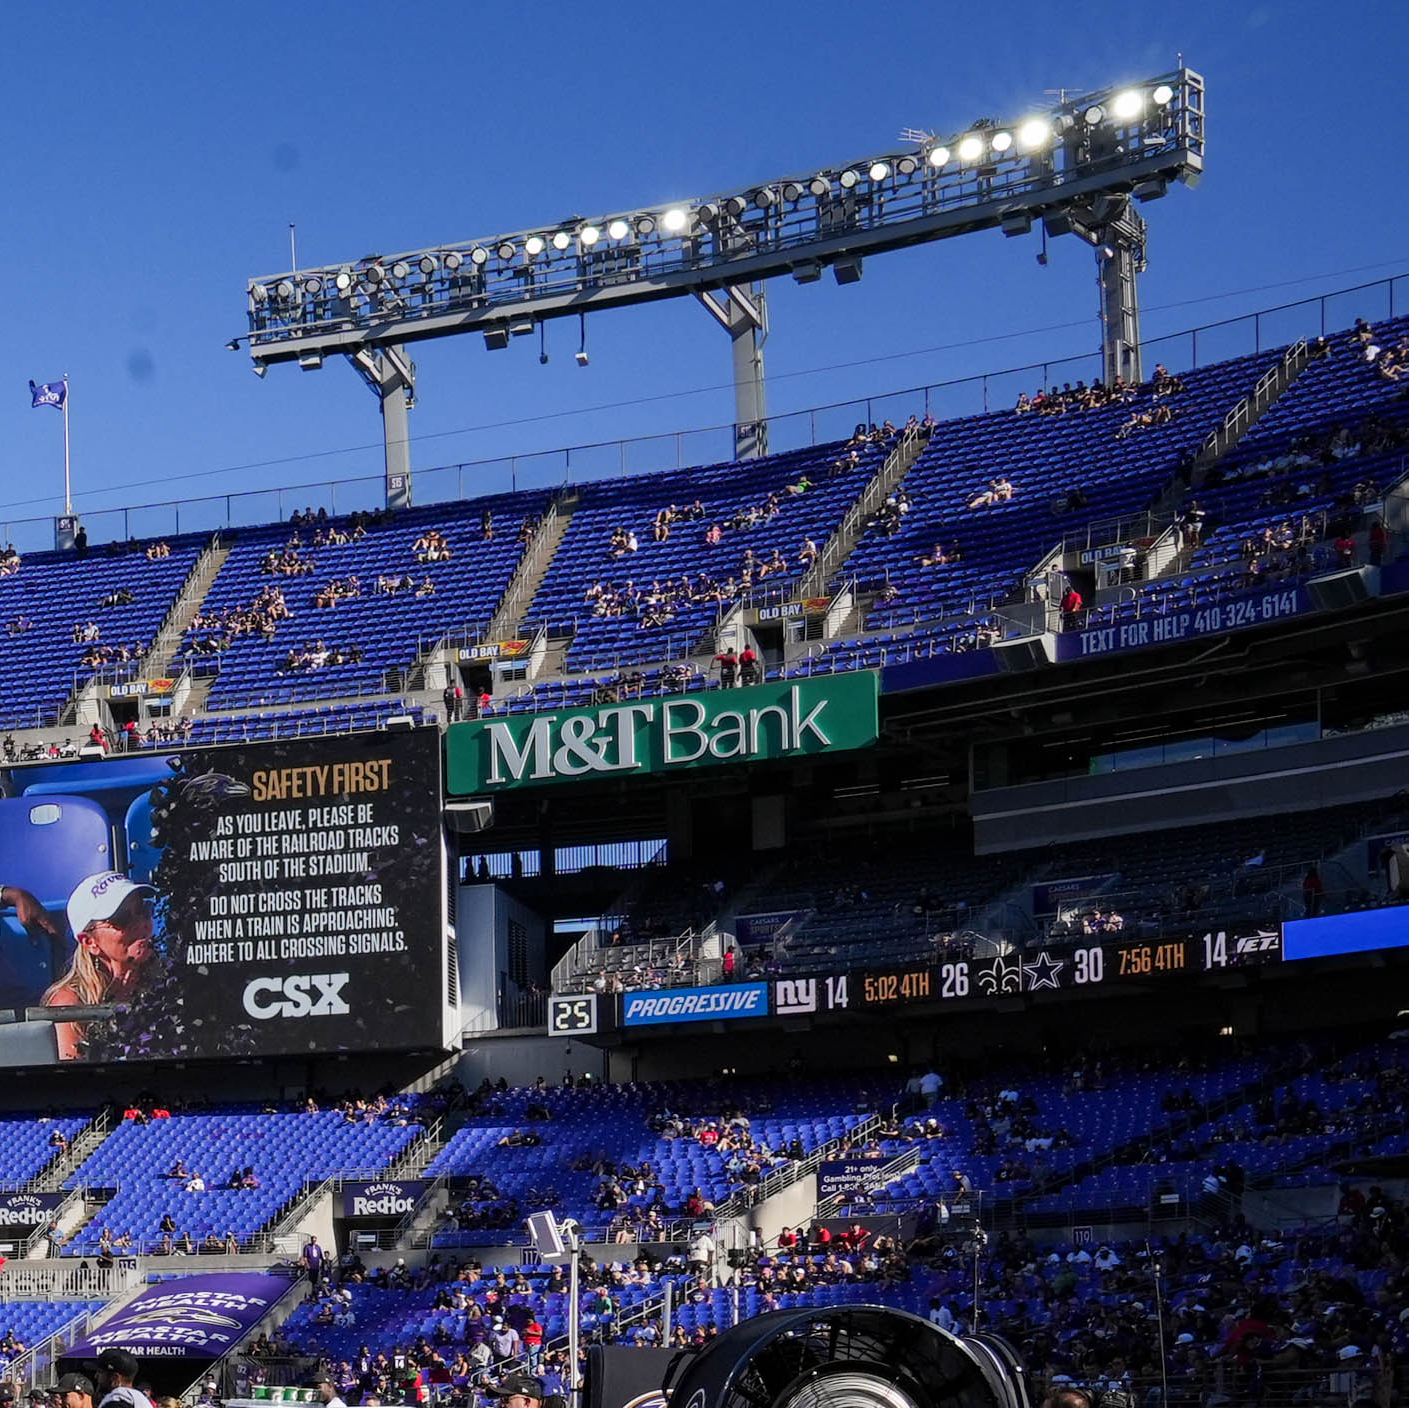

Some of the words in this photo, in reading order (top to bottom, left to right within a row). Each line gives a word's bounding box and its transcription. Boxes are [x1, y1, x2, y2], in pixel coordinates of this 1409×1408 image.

[1080, 551, 1102, 564] OLD
[759, 607, 780, 620] OLD
[781, 604, 801, 617] BAY
[1080, 629, 1115, 655] TEXT
[1120, 623, 1149, 648] FOR
[1153, 614, 1190, 643] HELP
[1193, 590, 1298, 632] 410-324-6141
[459, 648, 477, 660] OLD
[479, 645, 500, 657] BAY
[110, 686, 128, 697] OLD
[129, 684, 147, 695] BAY
[483, 703, 654, 785] M&T
[662, 685, 832, 765] Bank
[253, 765, 329, 801] SAFETY
[332, 759, 392, 795] FIRST
[216, 815, 233, 836] AS
[236, 813, 262, 834] YOU
[264, 810, 305, 832] LEAVE,
[308, 805, 355, 828] PLEASE
[358, 803, 373, 823] BE
[189, 839, 235, 861] AWARE
[236, 837, 253, 859] OF
[255, 835, 279, 857] THE
[282, 831, 345, 854] RAILROAD
[347, 825, 400, 848] TRACKS
[219, 861, 261, 883] SOUTH
[264, 860, 281, 880] OF
[282, 857, 306, 878] THE
[309, 852, 372, 876] STADIUM.
[210, 896, 228, 917] DO
[230, 893, 256, 915] NOT
[258, 890, 301, 913] CROSS
[304, 888, 328, 909] THE
[330, 884, 383, 907] TRACKS
[194, 919, 231, 942] WHEN
[234, 918, 244, 939] A
[246, 914, 284, 938] TRAIN
[286, 914, 300, 935] IS
[302, 907, 399, 934] APPROACHING.
[186, 942, 234, 965] ADHERE
[237, 941, 254, 962] TO
[256, 939, 278, 961] ALL
[280, 934, 346, 959] CROSSING
[349, 930, 409, 955] SIGNALS.
[1203, 931, 1227, 969] 14
[1074, 946, 1104, 984] 30
[1118, 947, 1152, 976] 7:56
[1154, 943, 1185, 972] 4TH
[242, 972, 351, 1020] CSX
[824, 976, 849, 1009] 14
[864, 975, 898, 1002] 5:02
[902, 972, 930, 997] 4TH
[942, 962, 969, 998] 26
[554, 1000, 591, 1030] 25
[625, 989, 762, 1019] PROGRESSIVE
[364, 1183, 403, 1196] FRANK'S
[823, 1174, 862, 1185] Gambling
[6, 1195, 43, 1207] FRANK'S
[352, 1195, 415, 1216] RedHot
[130, 1291, 267, 1308] MEDSTAR
[135, 1298, 248, 1312] HEALTH
[87, 1326, 230, 1343] MEDSTAR
[91, 1333, 209, 1346] HEALTH
[146, 1345, 186, 1356] HEALTH
